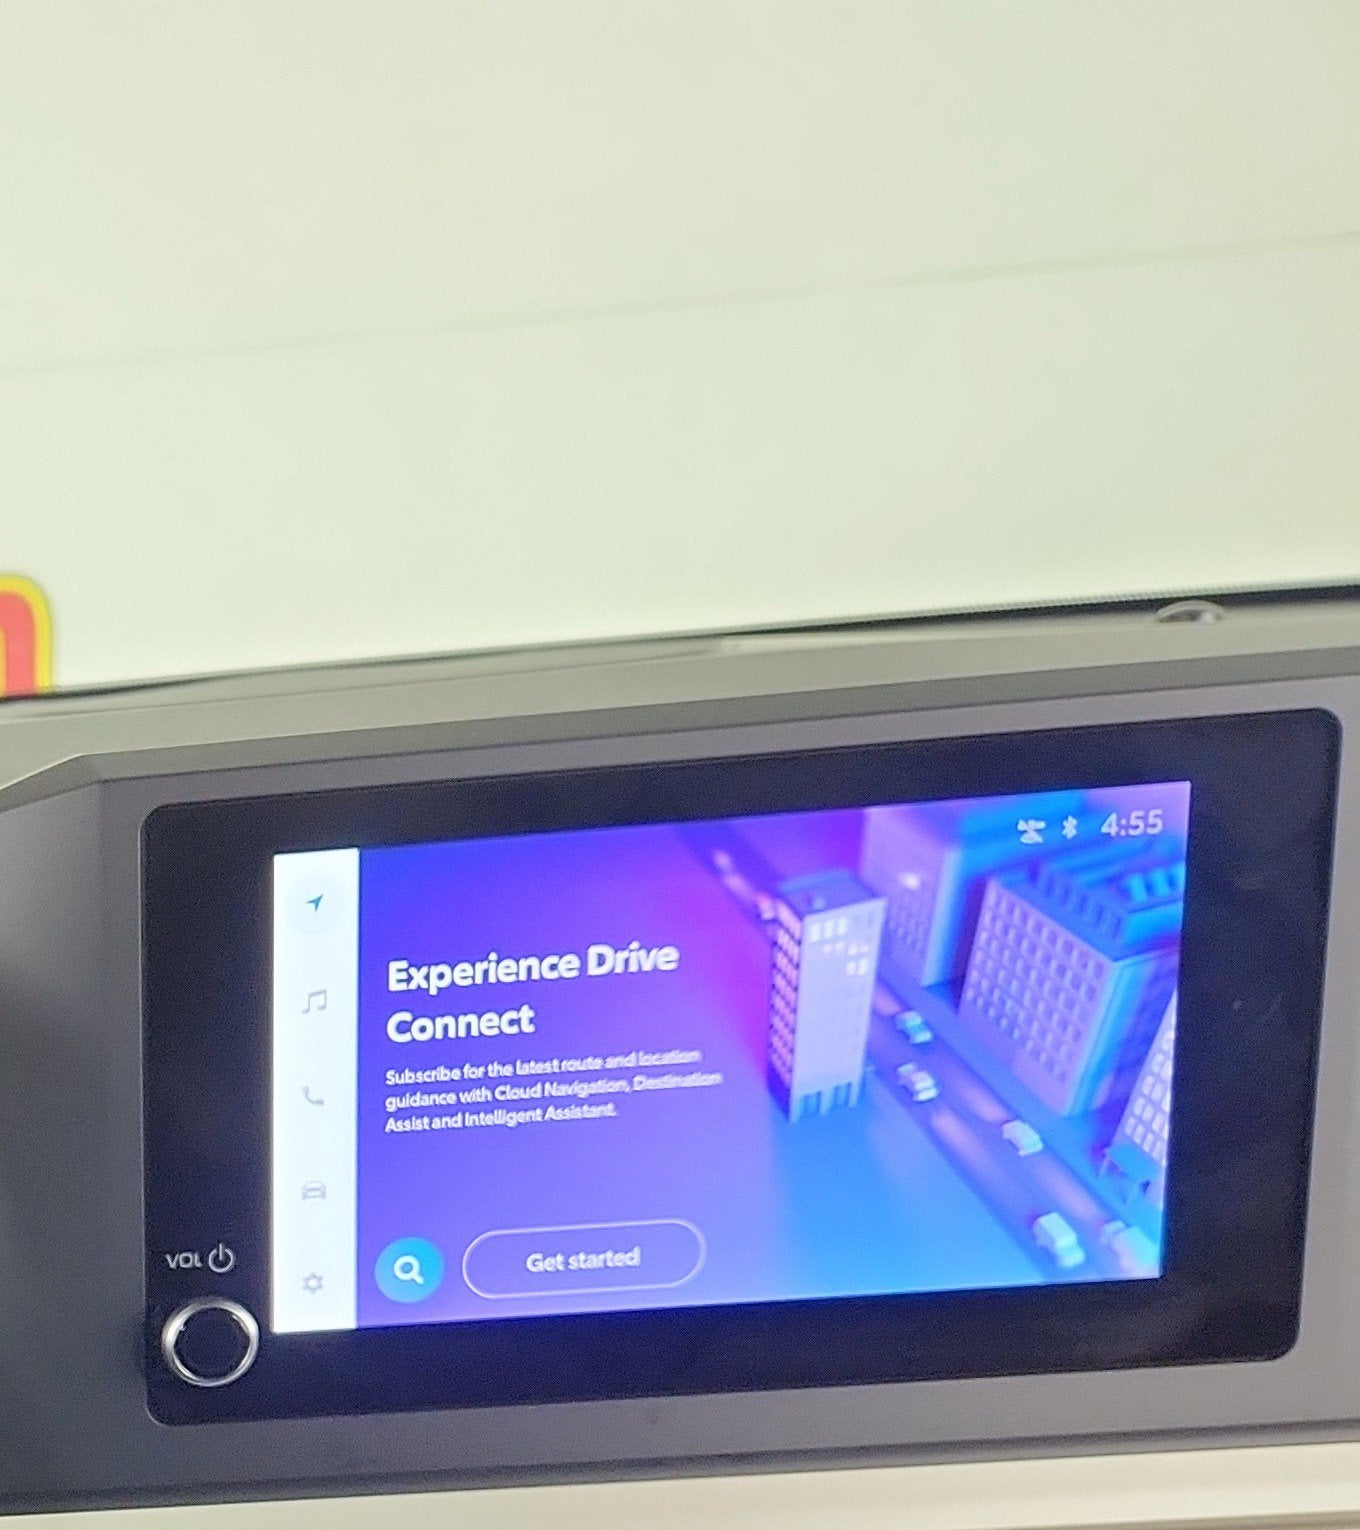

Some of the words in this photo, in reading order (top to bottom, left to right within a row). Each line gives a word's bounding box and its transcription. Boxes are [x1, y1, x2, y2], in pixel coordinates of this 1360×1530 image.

[1101, 809, 1164, 837] 4:55
[387, 951, 582, 995] Experience
[587, 941, 680, 977] Drive
[386, 1004, 536, 1043] Connect
[385, 1066, 461, 1085] Subscribe
[463, 1062, 486, 1079] for
[487, 1061, 514, 1077] the
[515, 1059, 560, 1076] latest
[561, 1056, 604, 1072] route
[605, 1050, 637, 1069] and
[639, 1049, 702, 1067] location
[385, 1091, 457, 1112] guidance
[459, 1086, 493, 1103] with
[494, 1082, 542, 1100] Cloud
[544, 1078, 630, 1099] Navigation,
[632, 1072, 723, 1091] Destination
[385, 1115, 430, 1133] Assist
[431, 1112, 462, 1130] and
[464, 1107, 543, 1127] Intelligent
[165, 1252, 203, 1269] VOL
[526, 1252, 565, 1273] Get
[567, 1245, 641, 1271] started
